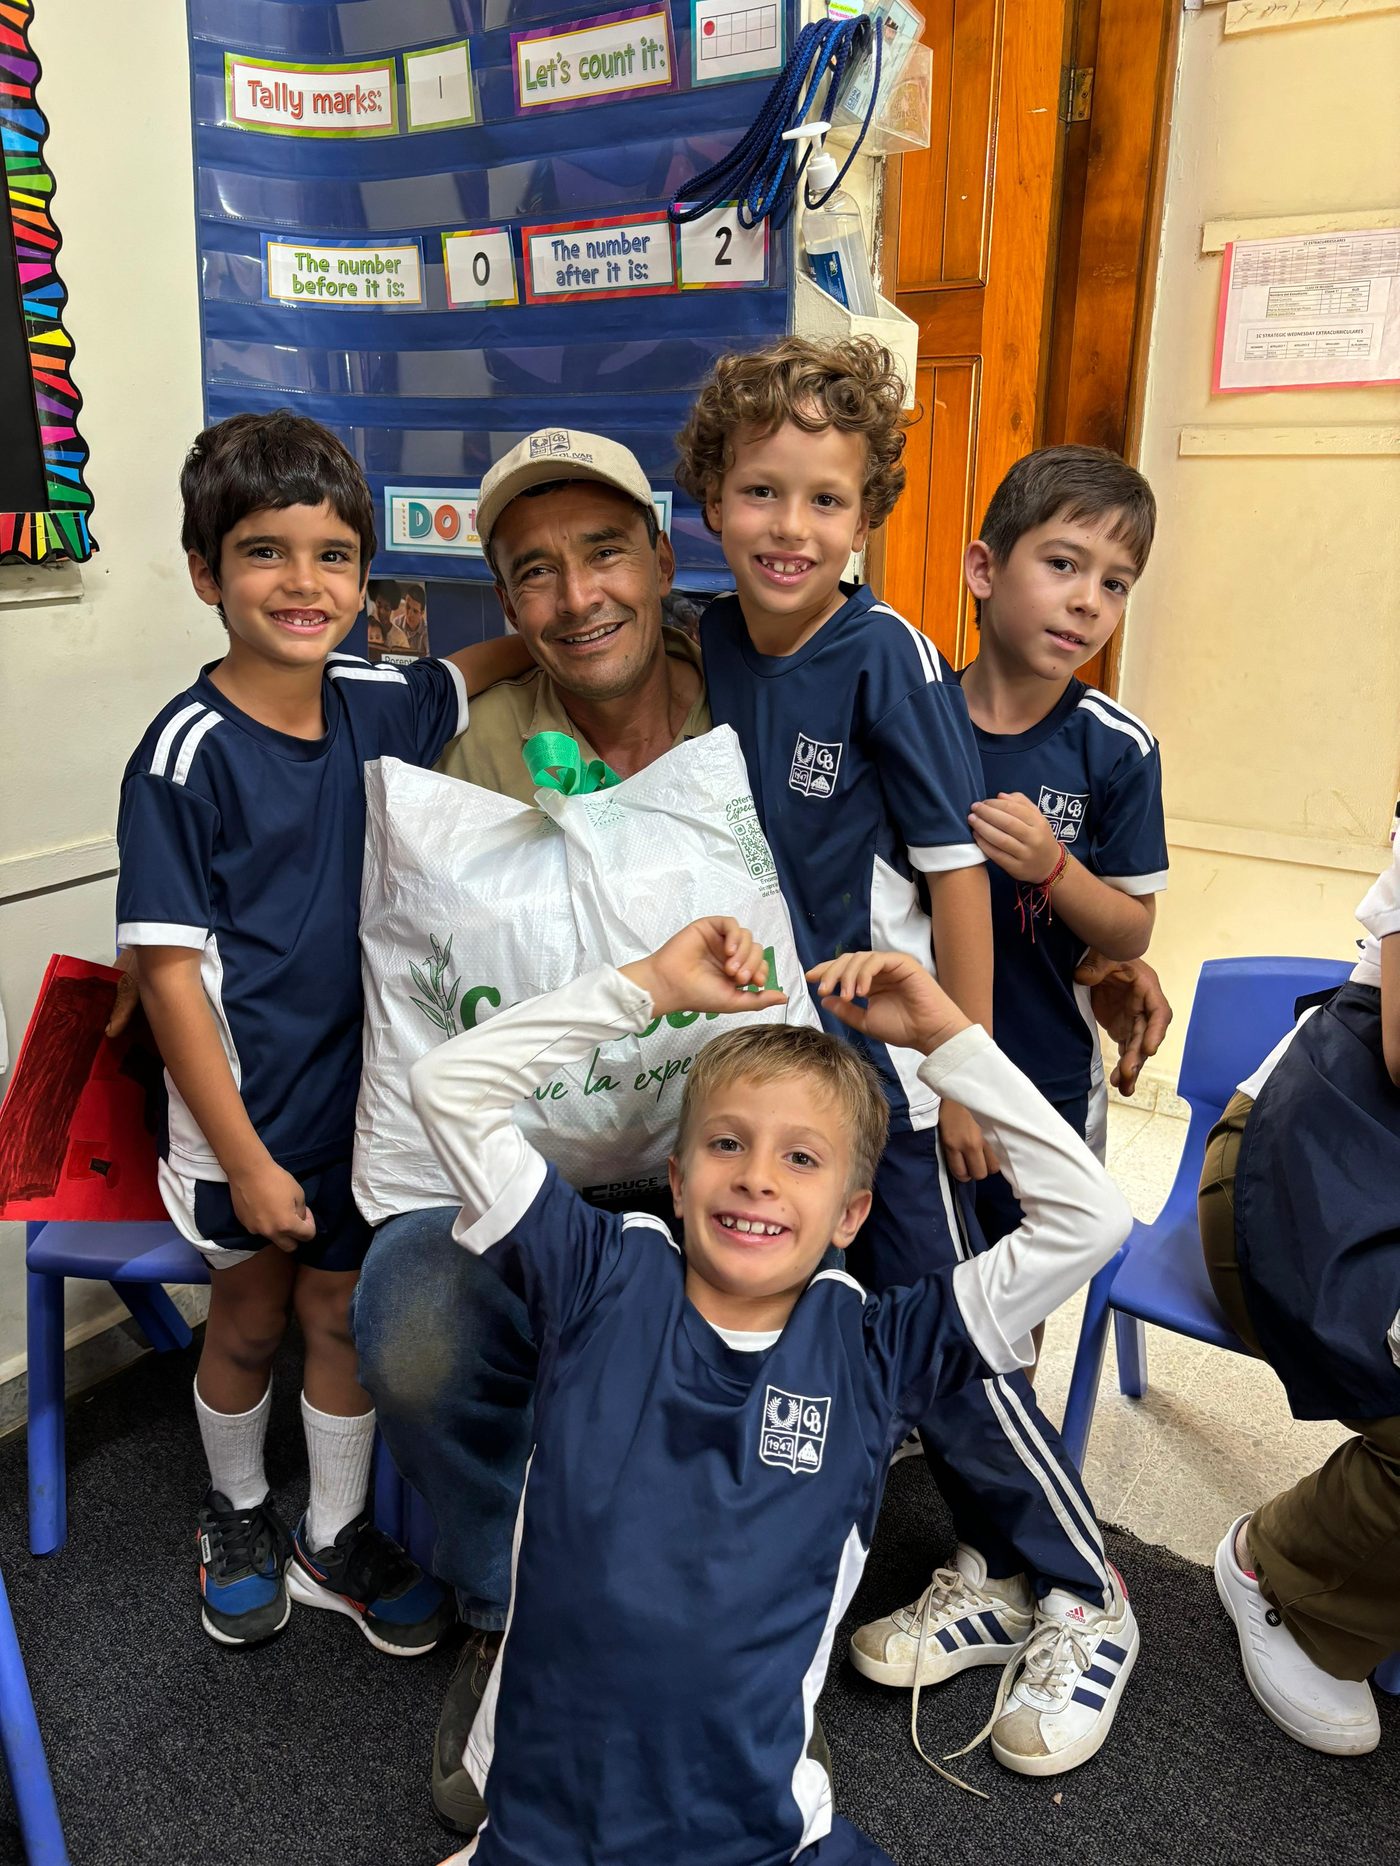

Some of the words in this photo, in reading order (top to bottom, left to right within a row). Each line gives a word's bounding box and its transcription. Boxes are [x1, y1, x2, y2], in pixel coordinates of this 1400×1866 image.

[524, 51, 571, 90] Let's
[578, 43, 636, 81] count
[640, 36, 666, 72] it:
[247, 79, 304, 120] Tally
[312, 84, 382, 115] marks:
[551, 239, 581, 263] The
[585, 231, 651, 259] number
[714, 226, 733, 266] 2
[294, 252, 330, 273] The
[337, 253, 402, 275] number
[472, 251, 491, 287] 0
[555, 263, 599, 287] after
[606, 260, 621, 283] it
[628, 258, 649, 281] is:
[292, 273, 358, 298] before
[365, 278, 380, 298] it
[386, 278, 405, 298] is:
[408, 501, 461, 541] DO
[731, 795, 753, 806] Ofert
[584, 1047, 620, 1096] la
[633, 1055, 698, 1103] expe
[768, 1439, 792, 1452] 1947
